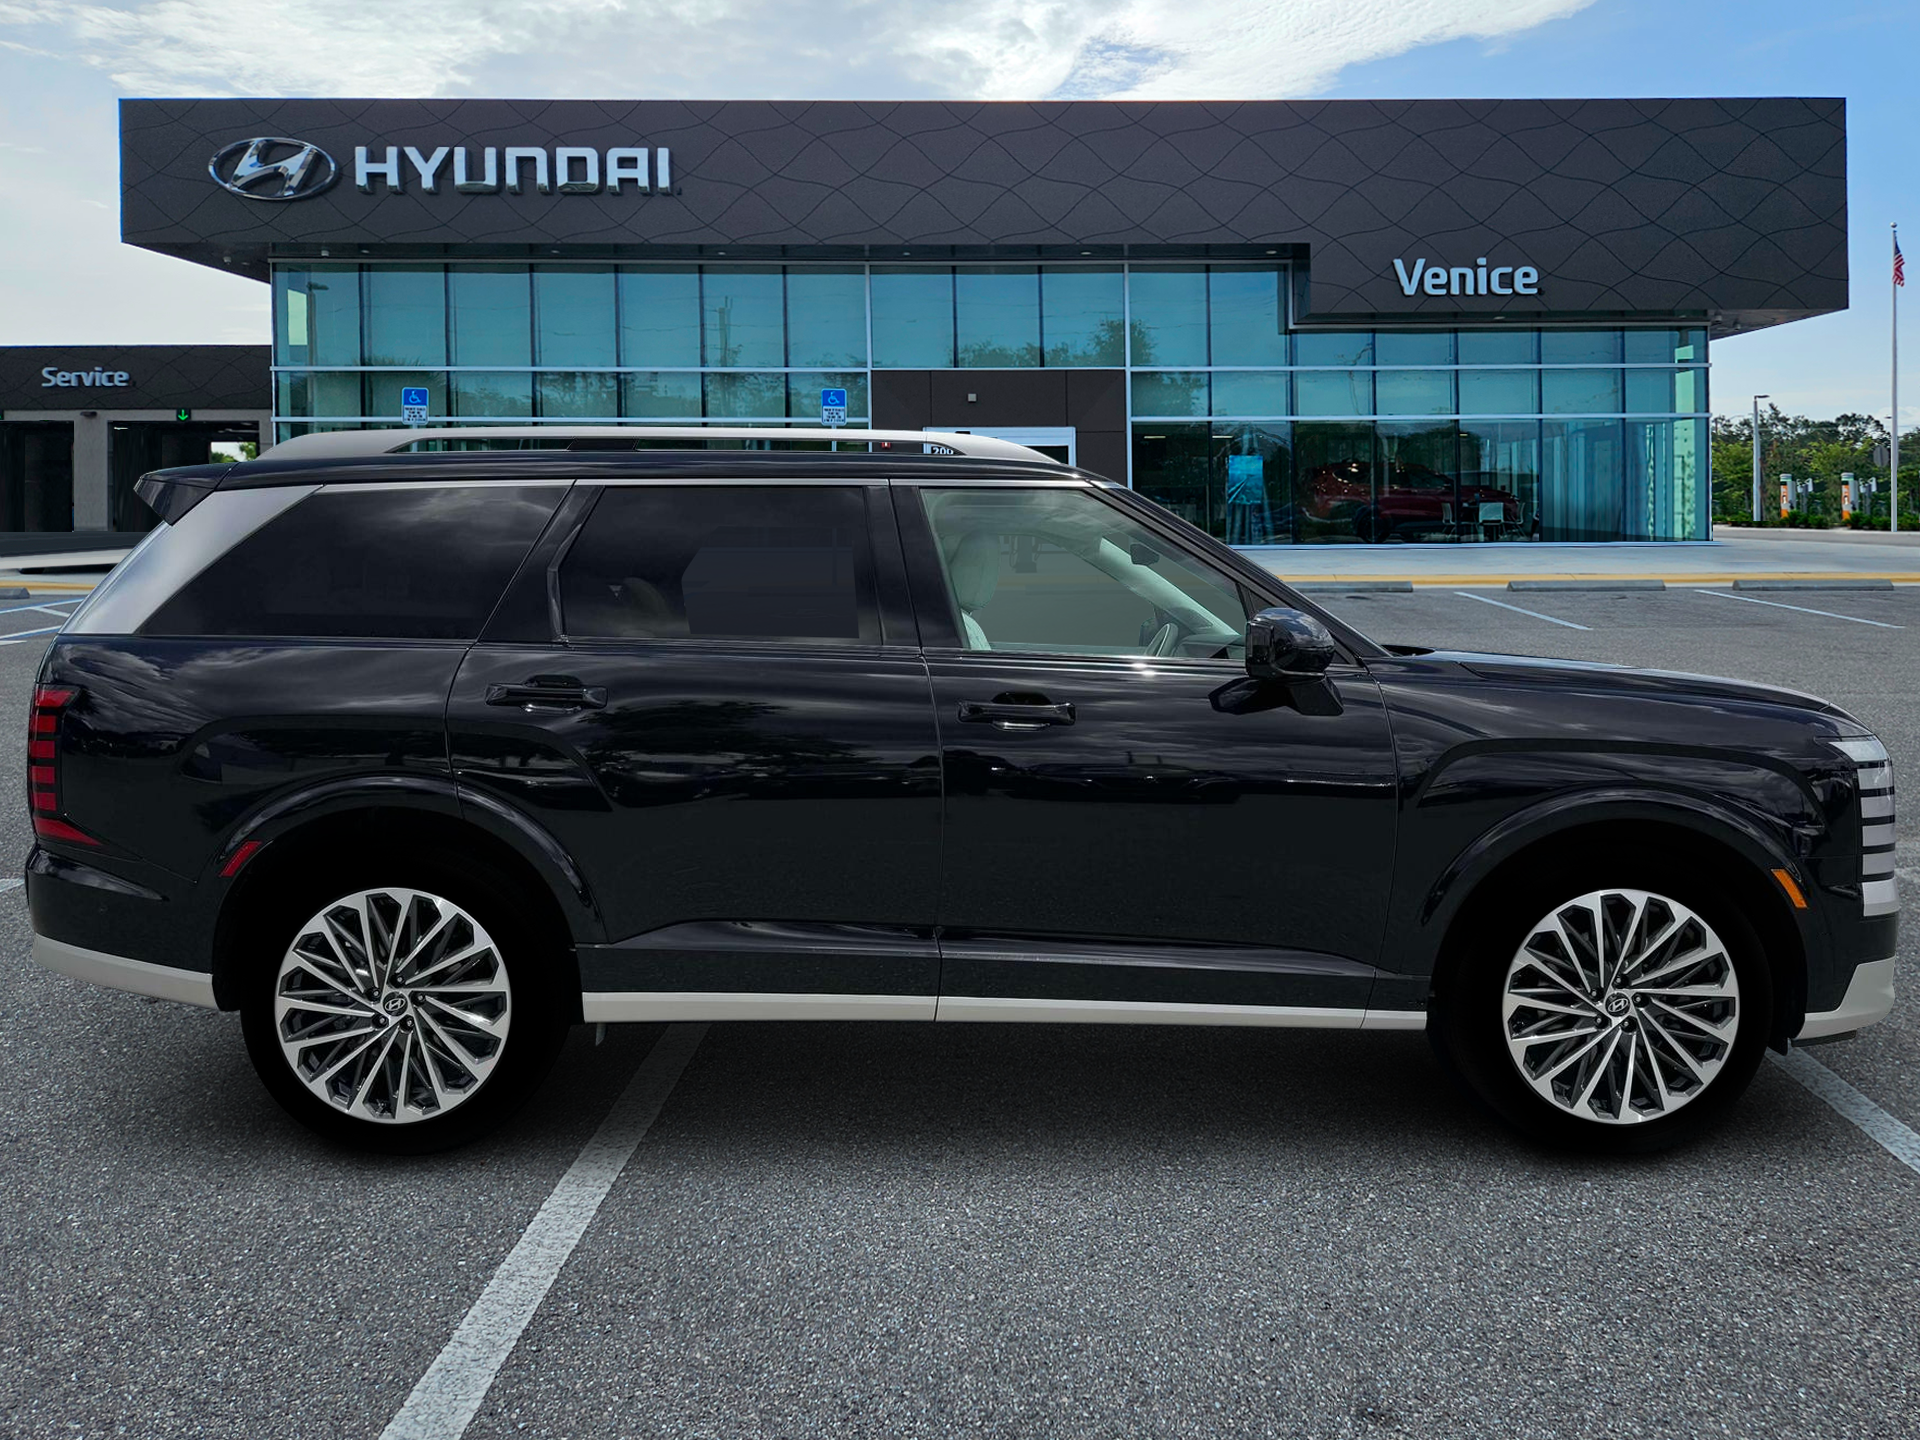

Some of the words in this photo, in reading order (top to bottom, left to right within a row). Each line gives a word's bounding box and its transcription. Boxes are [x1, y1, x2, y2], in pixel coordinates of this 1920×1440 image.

[354, 146, 671, 194] HYUNDAI
[1393, 257, 1539, 296] Venice
[41, 366, 130, 387] Service
